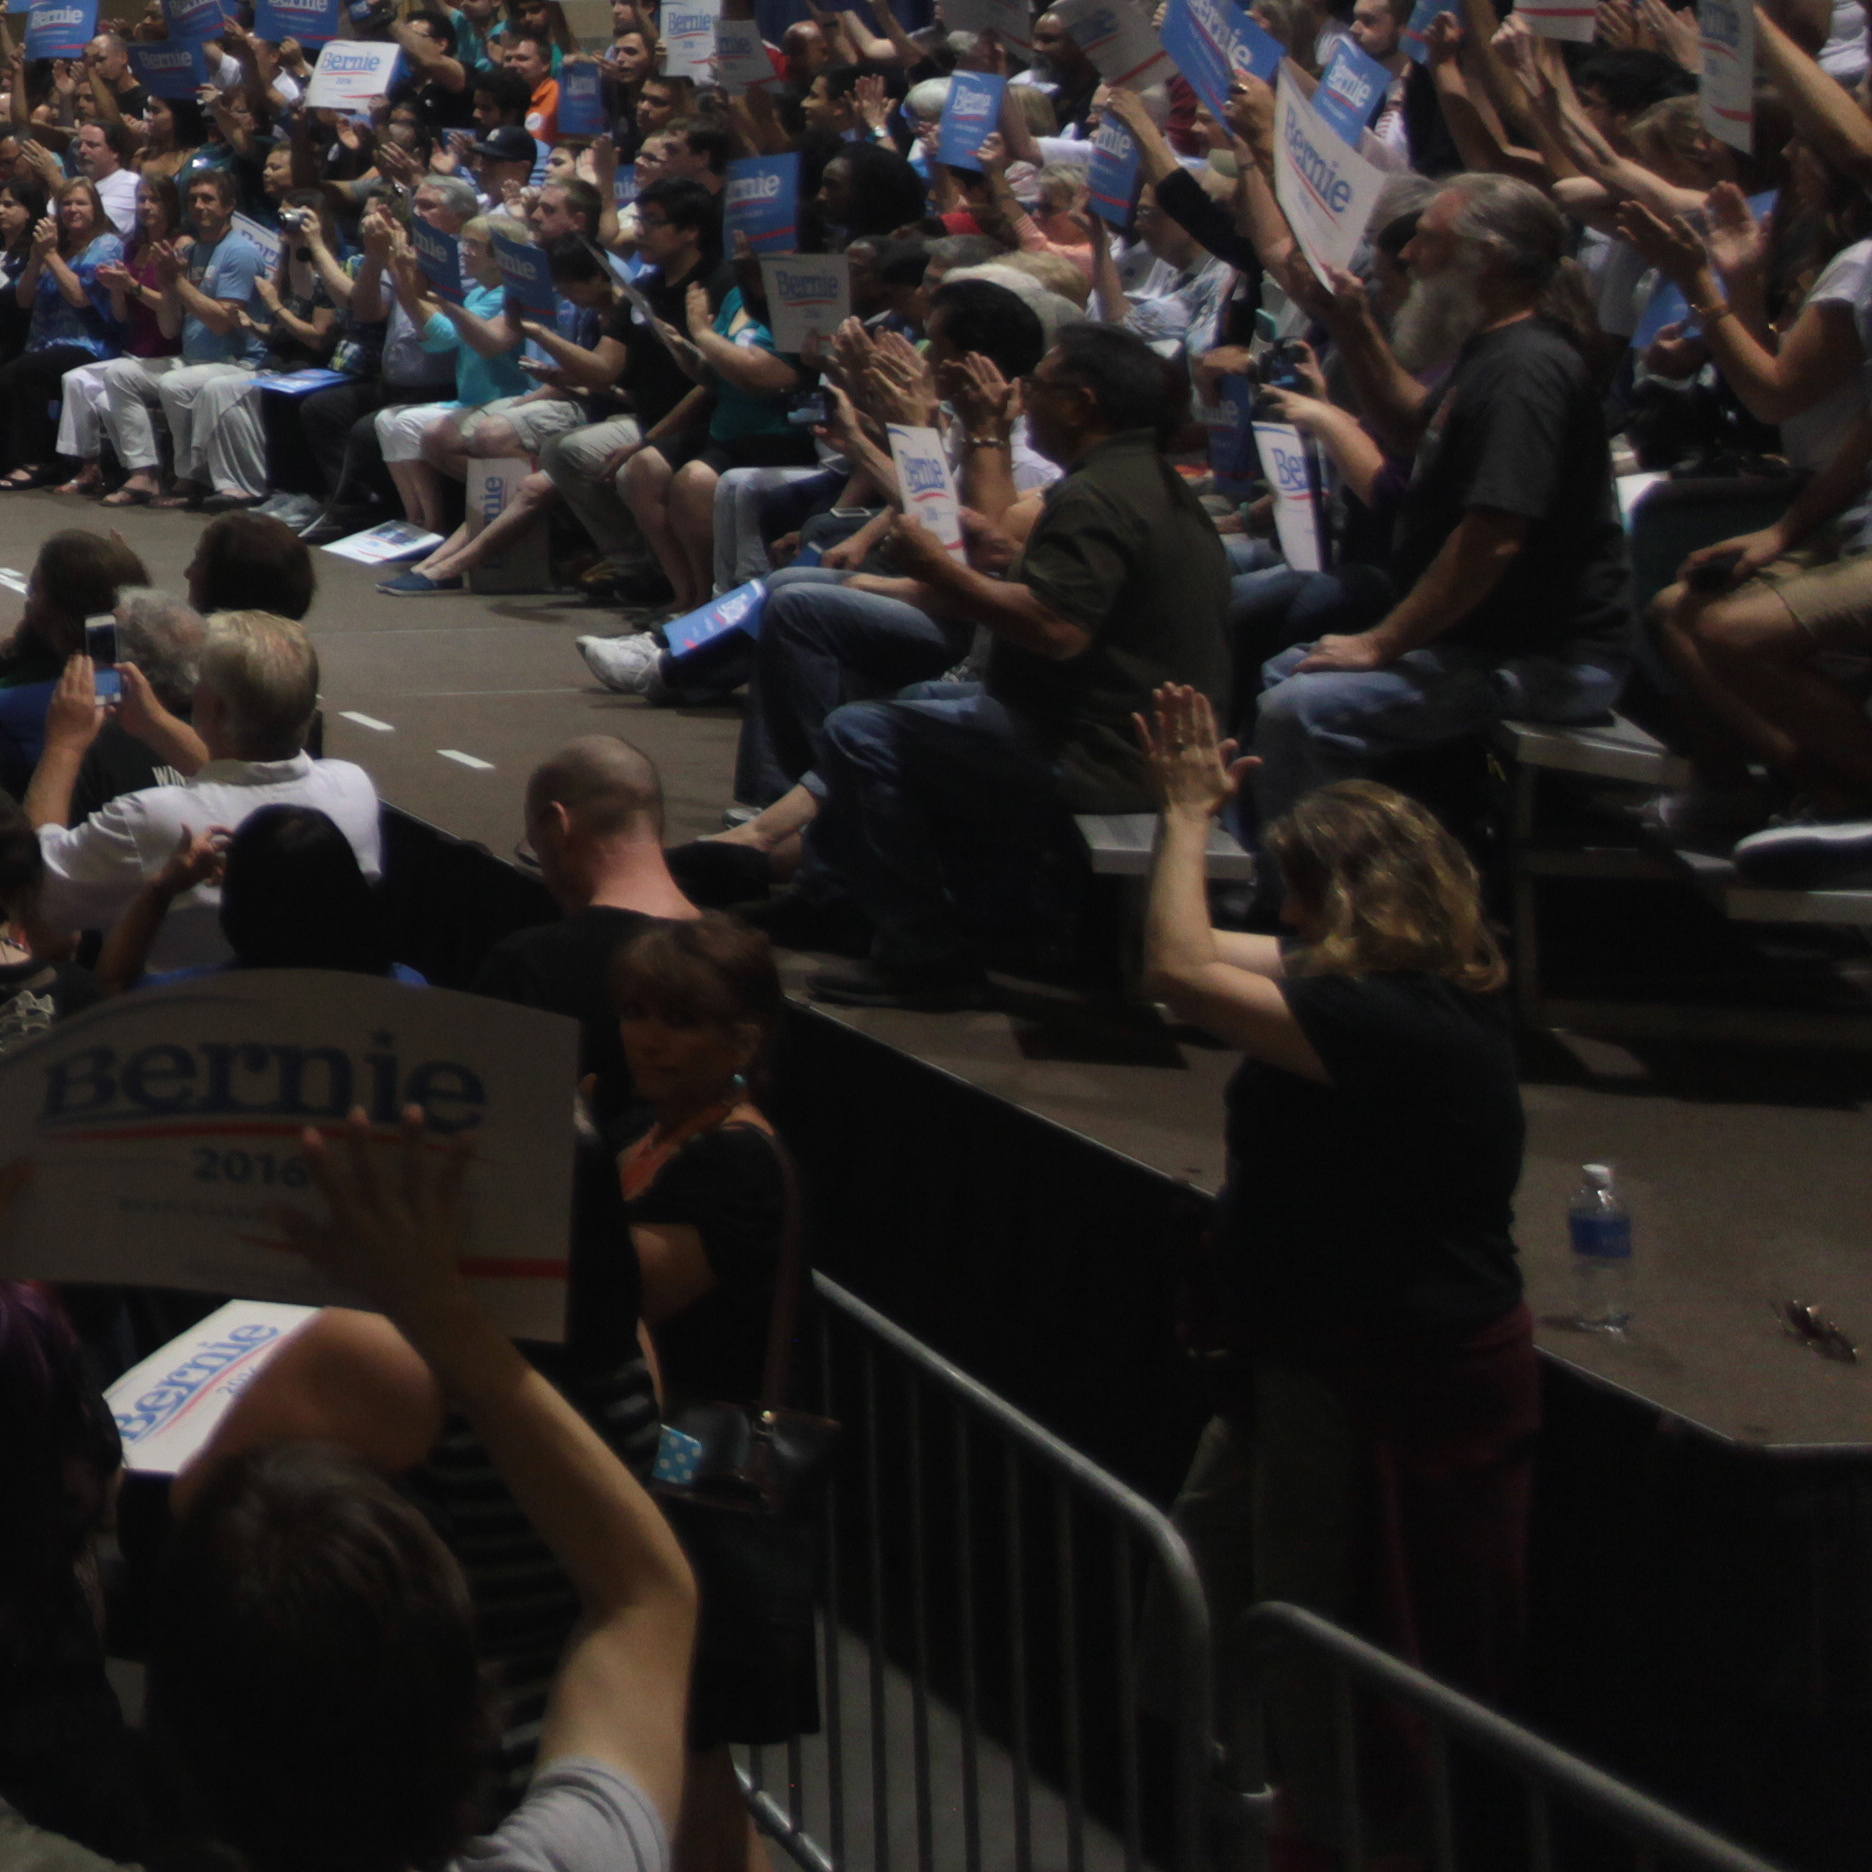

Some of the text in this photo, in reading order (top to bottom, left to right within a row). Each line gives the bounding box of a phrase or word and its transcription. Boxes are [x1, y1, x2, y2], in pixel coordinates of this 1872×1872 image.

[321, 51, 381, 72] Bernie
[42, 1030, 486, 1133] Bernie
[193, 1146, 310, 1189] 2016
[116, 1323, 281, 1444] Bernie
